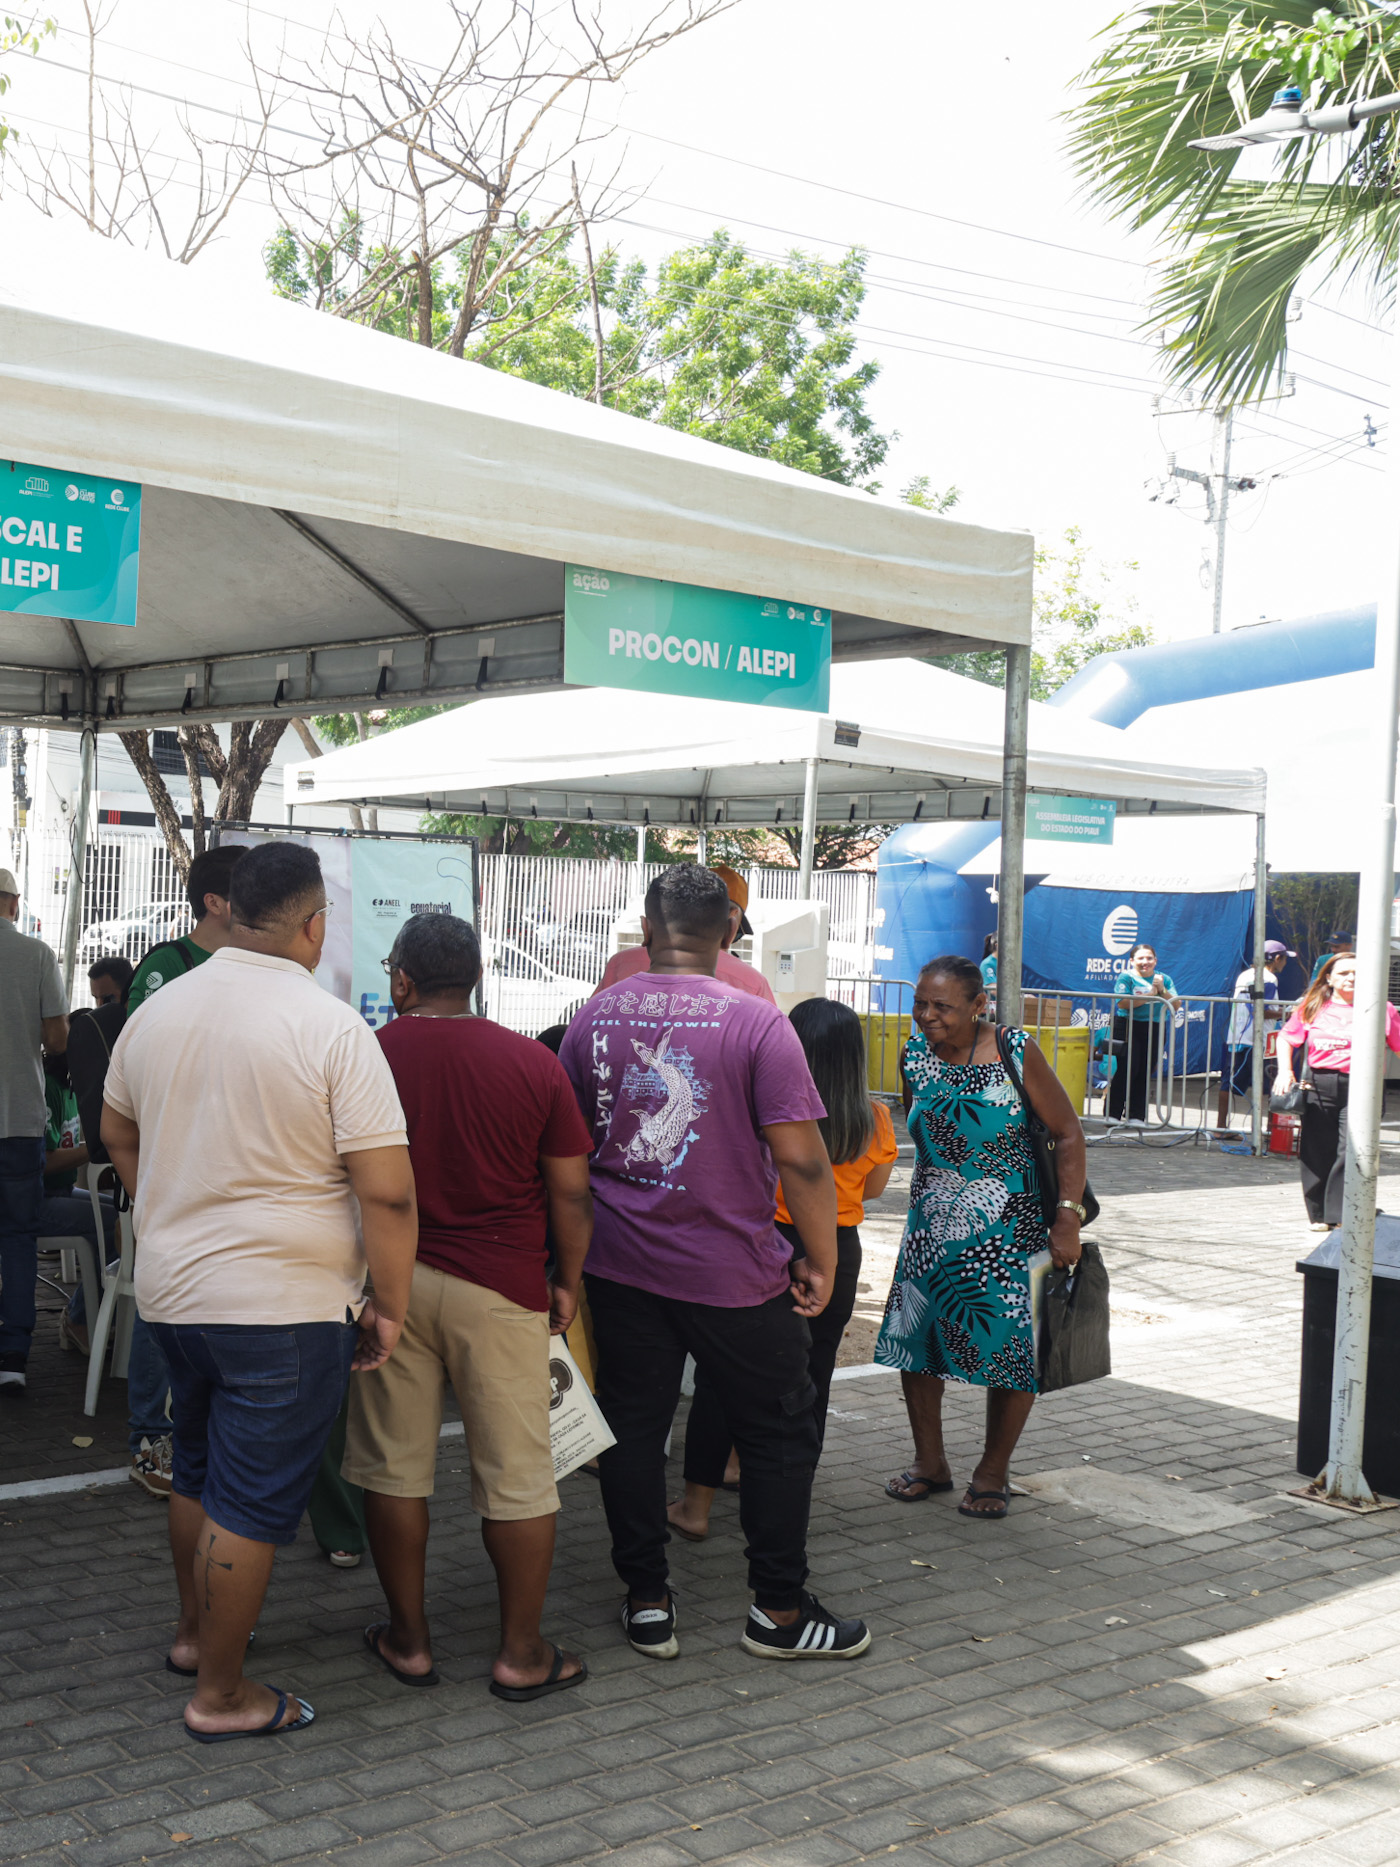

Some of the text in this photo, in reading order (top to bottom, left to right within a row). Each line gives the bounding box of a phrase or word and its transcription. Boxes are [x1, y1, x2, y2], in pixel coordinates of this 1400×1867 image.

[67, 525, 83, 553] E
[608, 627, 796, 679] PROCON / ALEPI
[1041, 824, 1050, 832] DO
[1051, 824, 1074, 834] ESTADO
[1074, 826, 1083, 834] DO
[384, 899, 401, 907] ANEEL
[1086, 958, 1112, 973] REDE
[629, 1020, 658, 1028] THE
